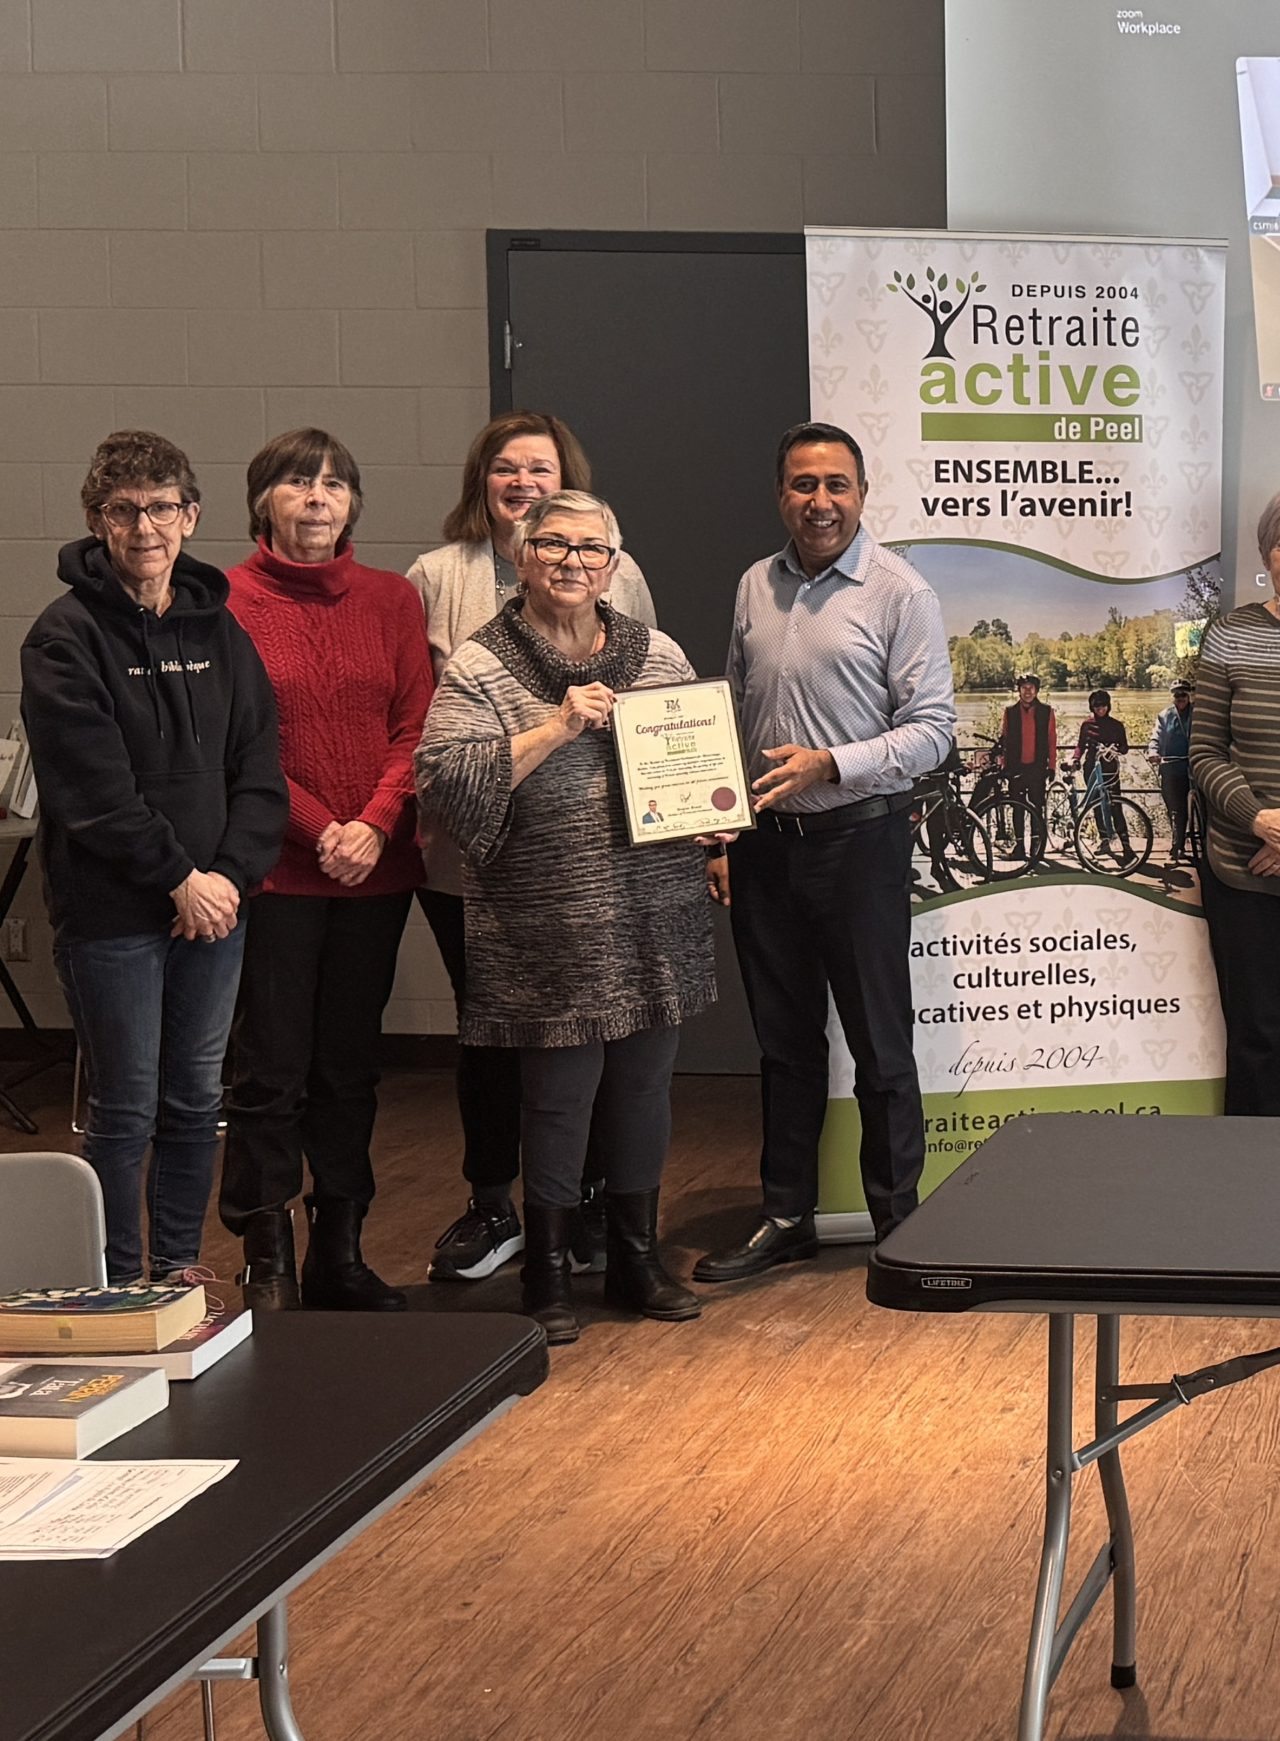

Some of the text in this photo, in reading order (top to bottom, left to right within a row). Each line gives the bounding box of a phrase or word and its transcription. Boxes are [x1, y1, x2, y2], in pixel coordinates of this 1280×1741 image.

[1117, 10, 1143, 19] zoom
[1117, 21, 1181, 36] Workplace
[1011, 284, 1139, 300] DEPUIS 2004
[972, 304, 1140, 348] Retraite
[919, 350, 1141, 407] active
[1053, 417, 1140, 441] de Peel
[934, 459, 1120, 485] ENSEMBLE...
[921, 490, 1133, 518] vers l'avenir!
[635, 715, 717, 737] Congratulations!
[910, 928, 1138, 958] activités sociales,
[952, 963, 1097, 990] culturelles,
[912, 994, 1181, 1026] catives et physiques
[948, 1040, 1104, 1098] depuis 2004
